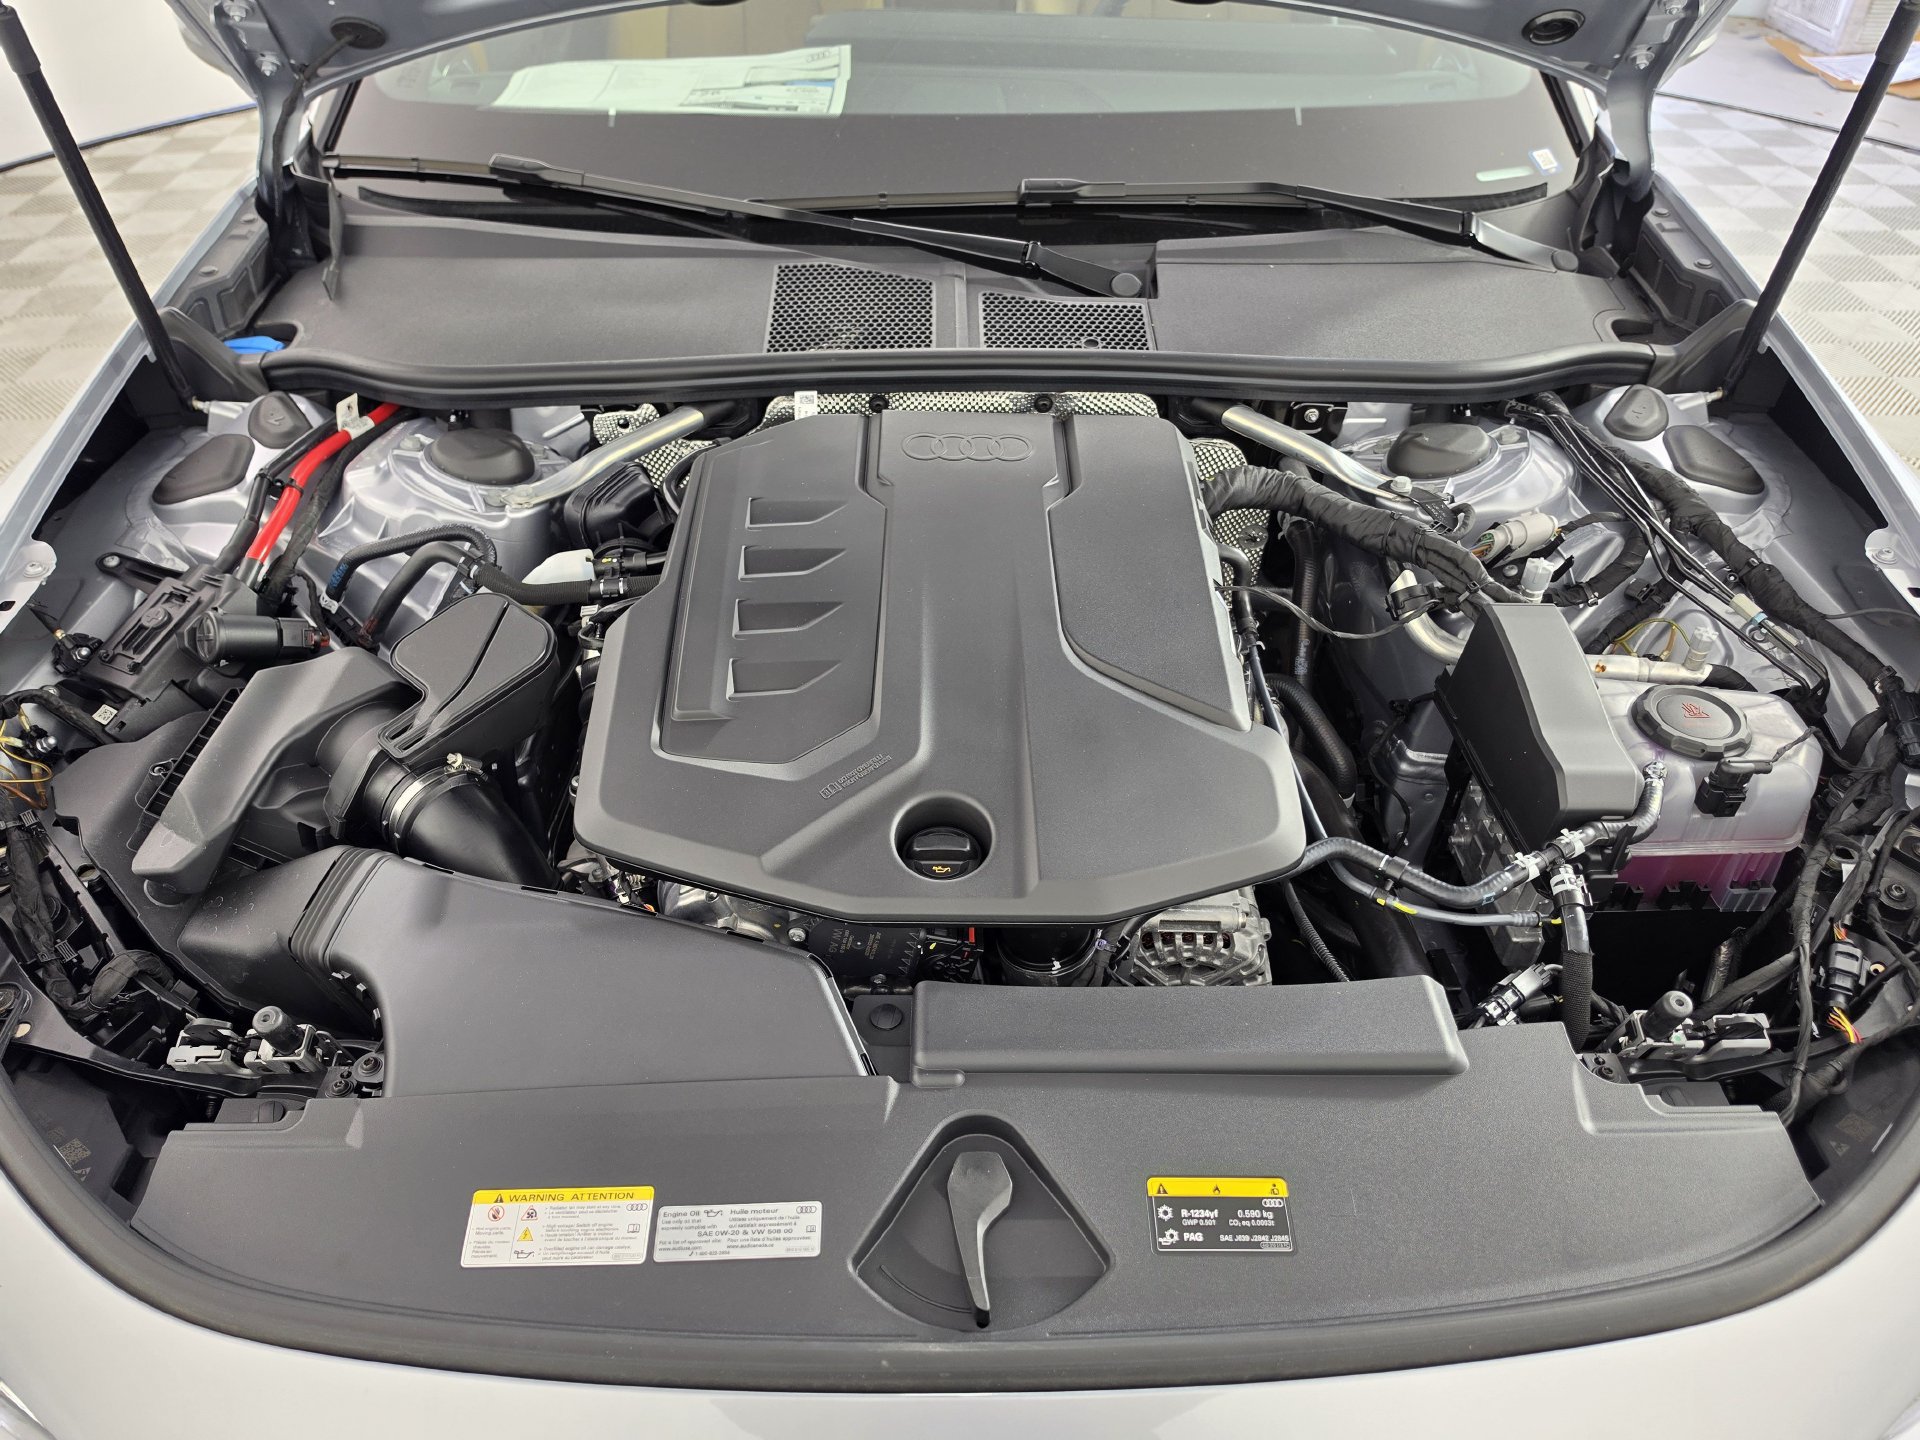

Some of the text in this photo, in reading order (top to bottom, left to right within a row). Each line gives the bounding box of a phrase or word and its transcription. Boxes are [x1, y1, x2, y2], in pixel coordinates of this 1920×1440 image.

[828, 941, 838, 953] AG
[509, 1192, 635, 1202] WARNING ATTENTION
[1181, 1208, 1219, 1219] R-1234yf
[1237, 1209, 1274, 1219] 0.590 kg
[1183, 1232, 1204, 1242] PAG
[1219, 1234, 1234, 1242] SAE
